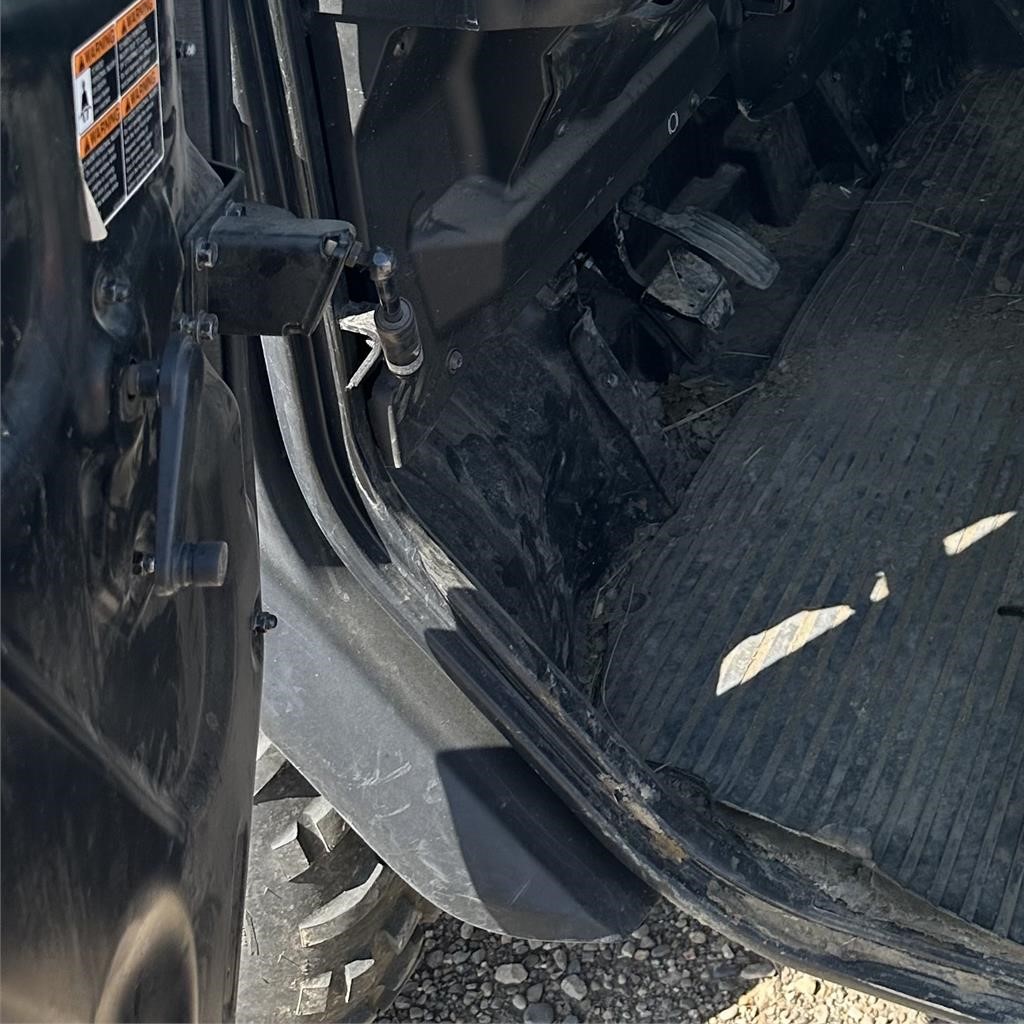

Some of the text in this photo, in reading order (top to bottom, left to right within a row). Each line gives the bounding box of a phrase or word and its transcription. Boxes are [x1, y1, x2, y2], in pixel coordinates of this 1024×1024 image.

[85, 28, 115, 62] WARNING
[130, 73, 156, 106] WARNING
[90, 107, 120, 144] WARNING
